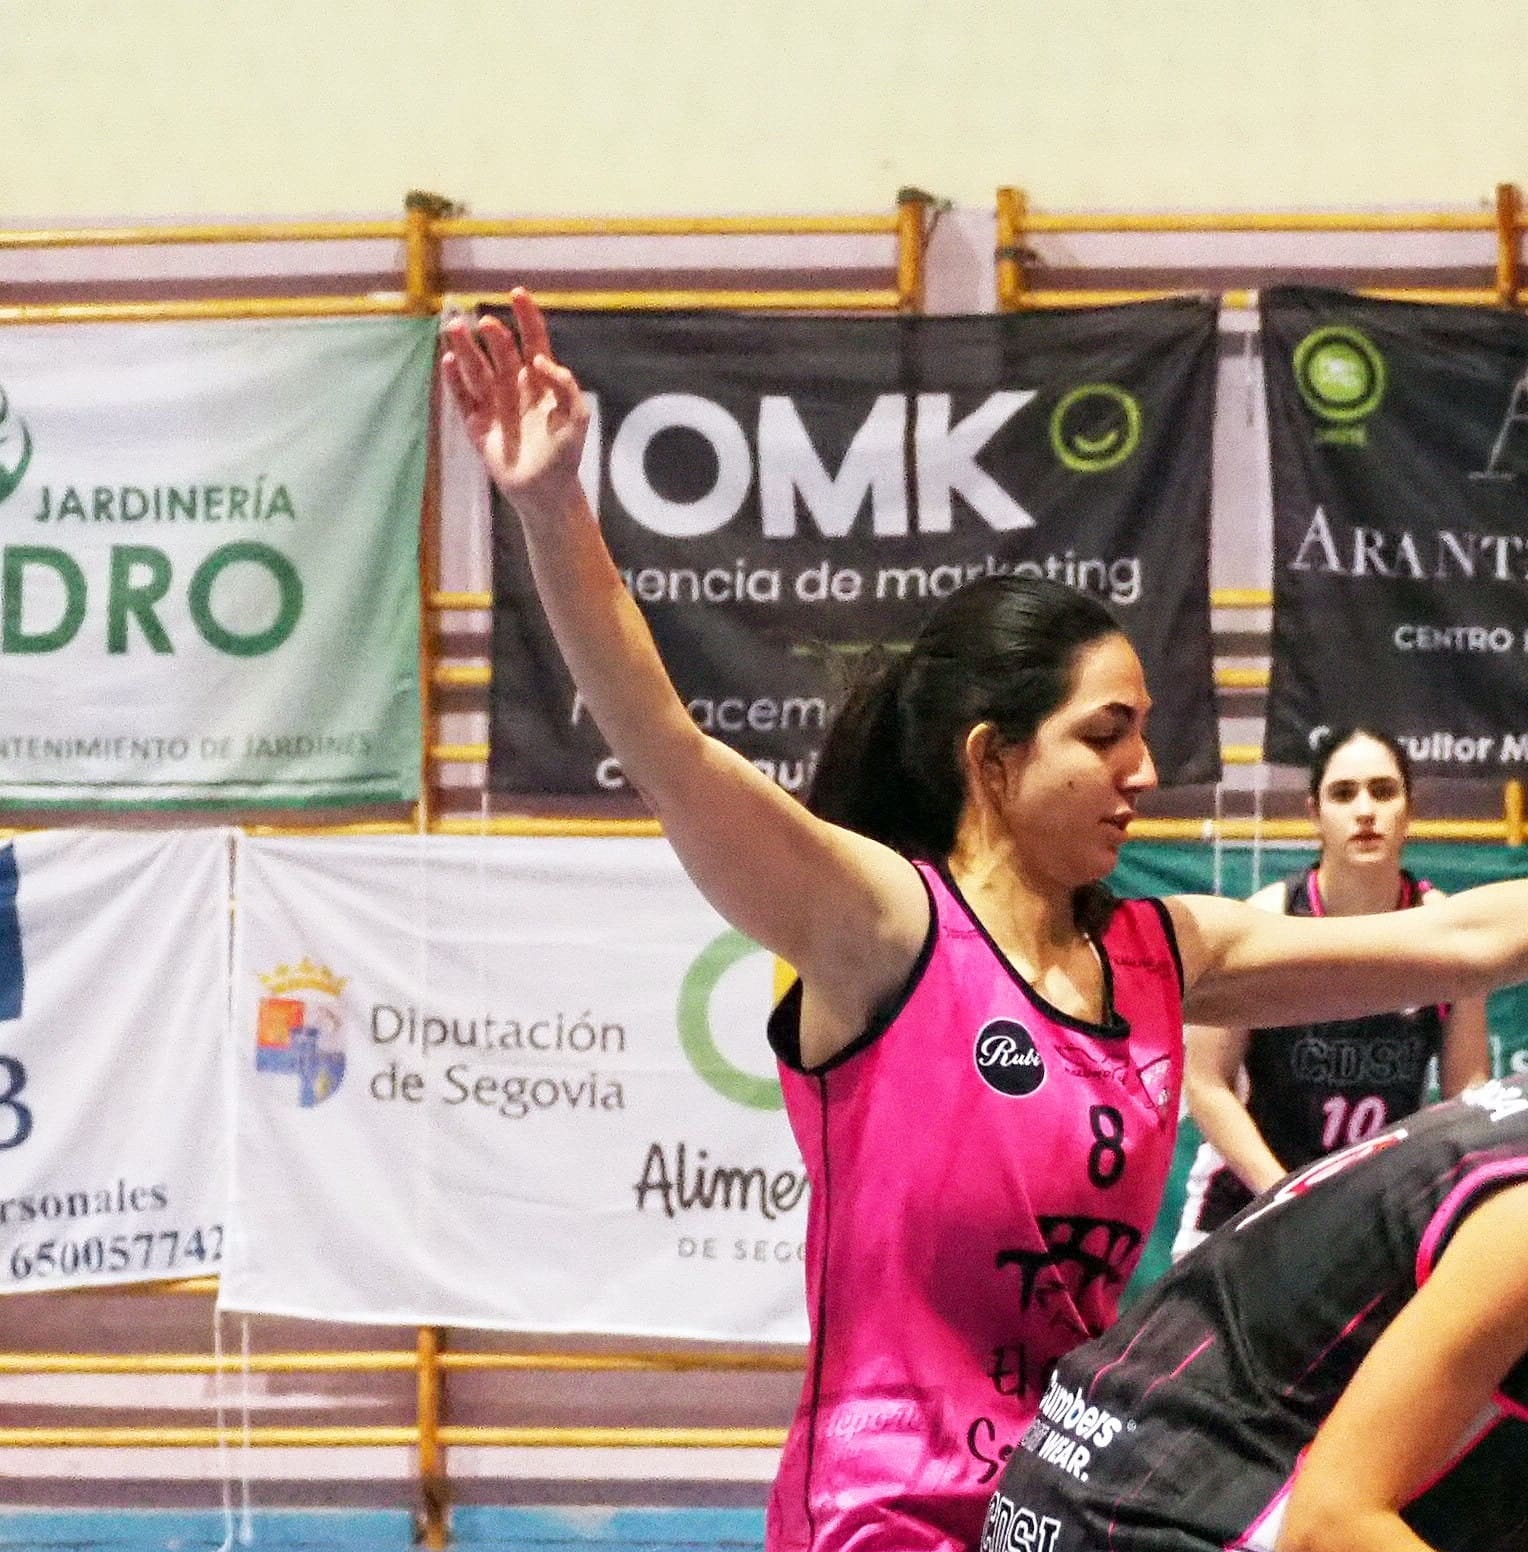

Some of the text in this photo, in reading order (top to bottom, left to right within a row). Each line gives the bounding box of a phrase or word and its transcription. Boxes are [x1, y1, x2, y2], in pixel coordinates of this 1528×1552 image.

[35, 475, 296, 523] JARDINERÍA
[795, 560, 862, 601] de
[1394, 625, 1515, 654] CENTRO
[371, 1003, 627, 1053] Diputación
[371, 1063, 626, 1118] de Segovia
[1087, 1103, 1126, 1190] 8
[1322, 1096, 1388, 1152] 10
[634, 1141, 812, 1220] Alime
[678, 1237, 718, 1260] DE
